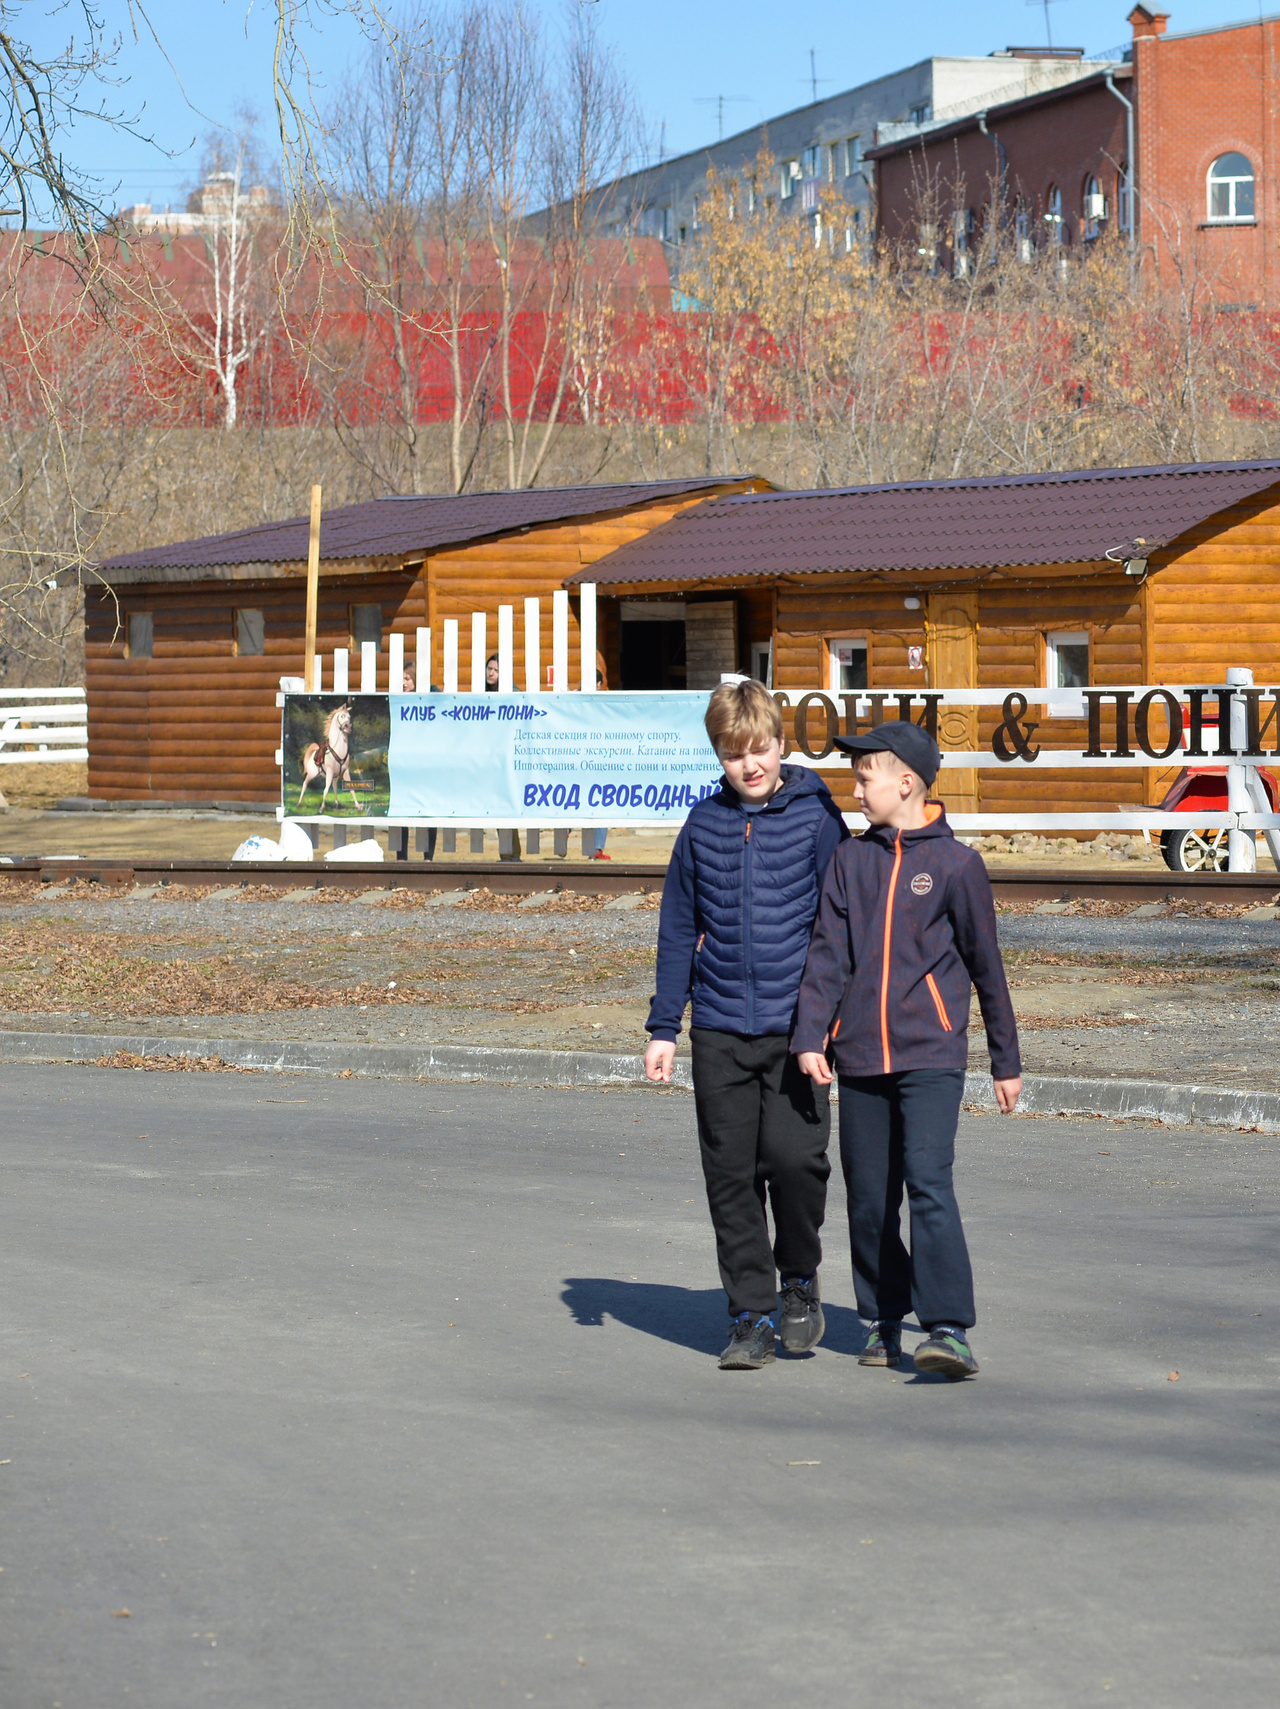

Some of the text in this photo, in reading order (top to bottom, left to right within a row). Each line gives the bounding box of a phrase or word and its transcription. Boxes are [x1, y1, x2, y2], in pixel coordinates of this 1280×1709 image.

[400, 705, 436, 721] КЛУБ
[992, 692, 1041, 762] &
[513, 729, 681, 743] Детская секция по конному спорту.
[514, 745, 582, 756] Коллективные
[584, 747, 635, 758] экскурсии.
[637, 745, 677, 756] Катание
[679, 748, 690, 756] на
[513, 760, 578, 773] Иппотерапия.
[580, 760, 625, 771] Общение
[627, 763, 633, 771] с
[635, 763, 659, 771] пони
[661, 763, 668, 771] и
[523, 783, 581, 811] ВХОД
